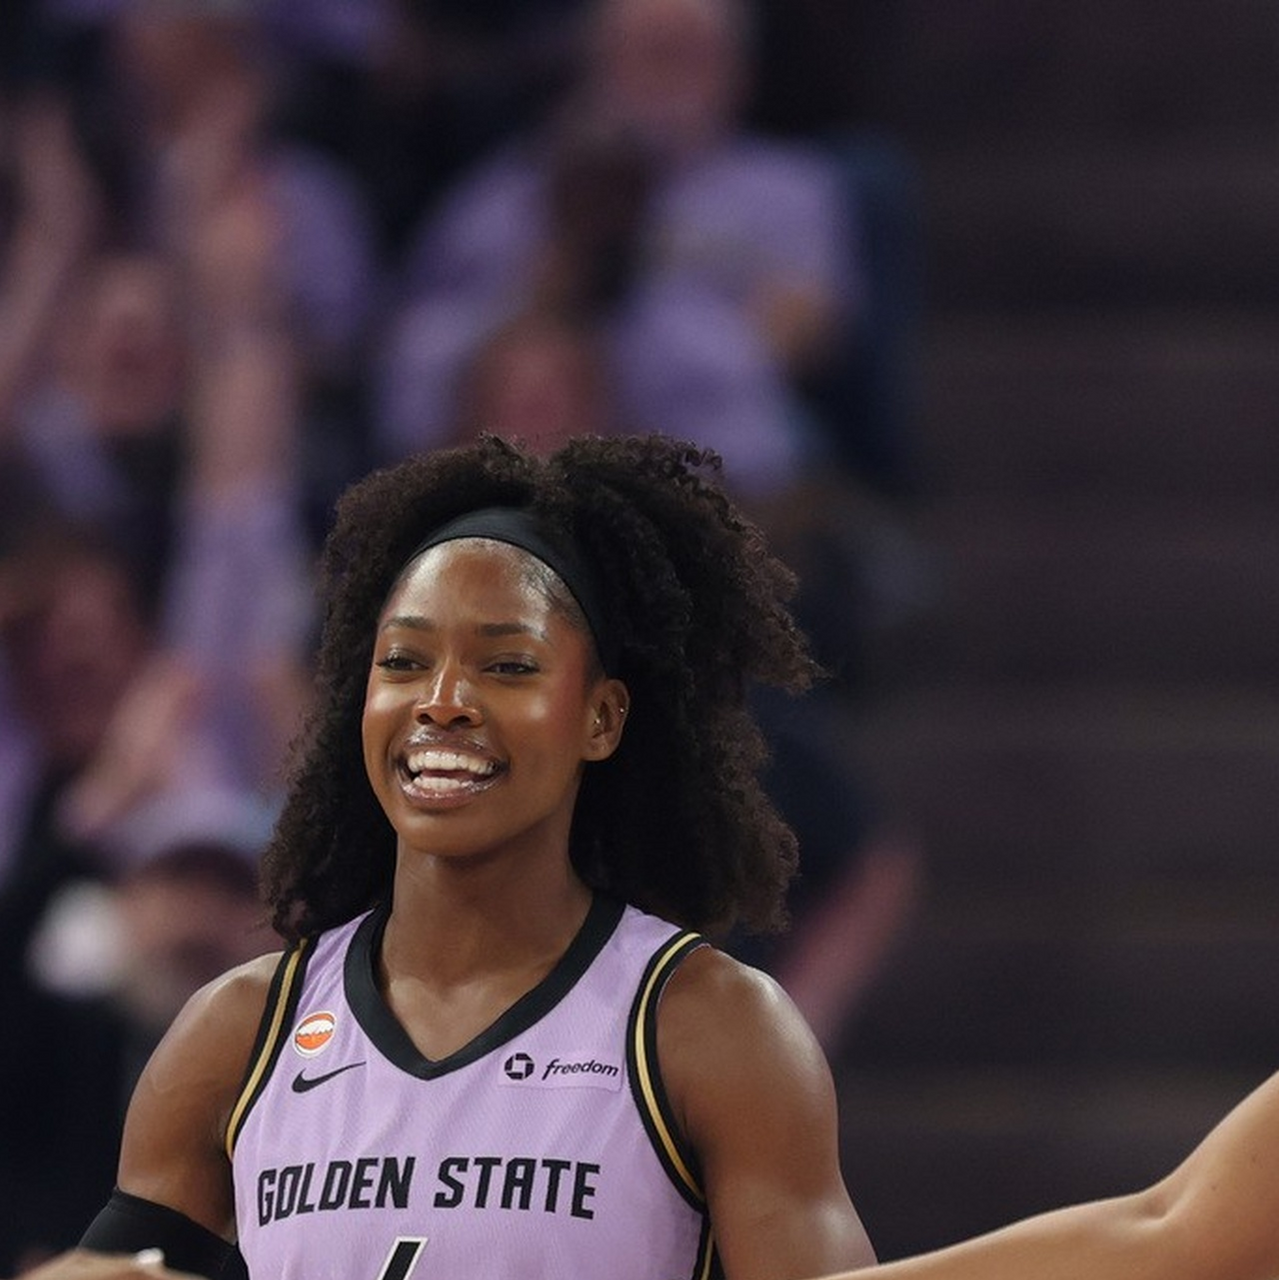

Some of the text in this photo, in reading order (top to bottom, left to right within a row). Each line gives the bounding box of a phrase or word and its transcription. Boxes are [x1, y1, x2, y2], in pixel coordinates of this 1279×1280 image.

[541, 1058, 619, 1081] freedom
[258, 1156, 601, 1227] GOLDEN STATE
